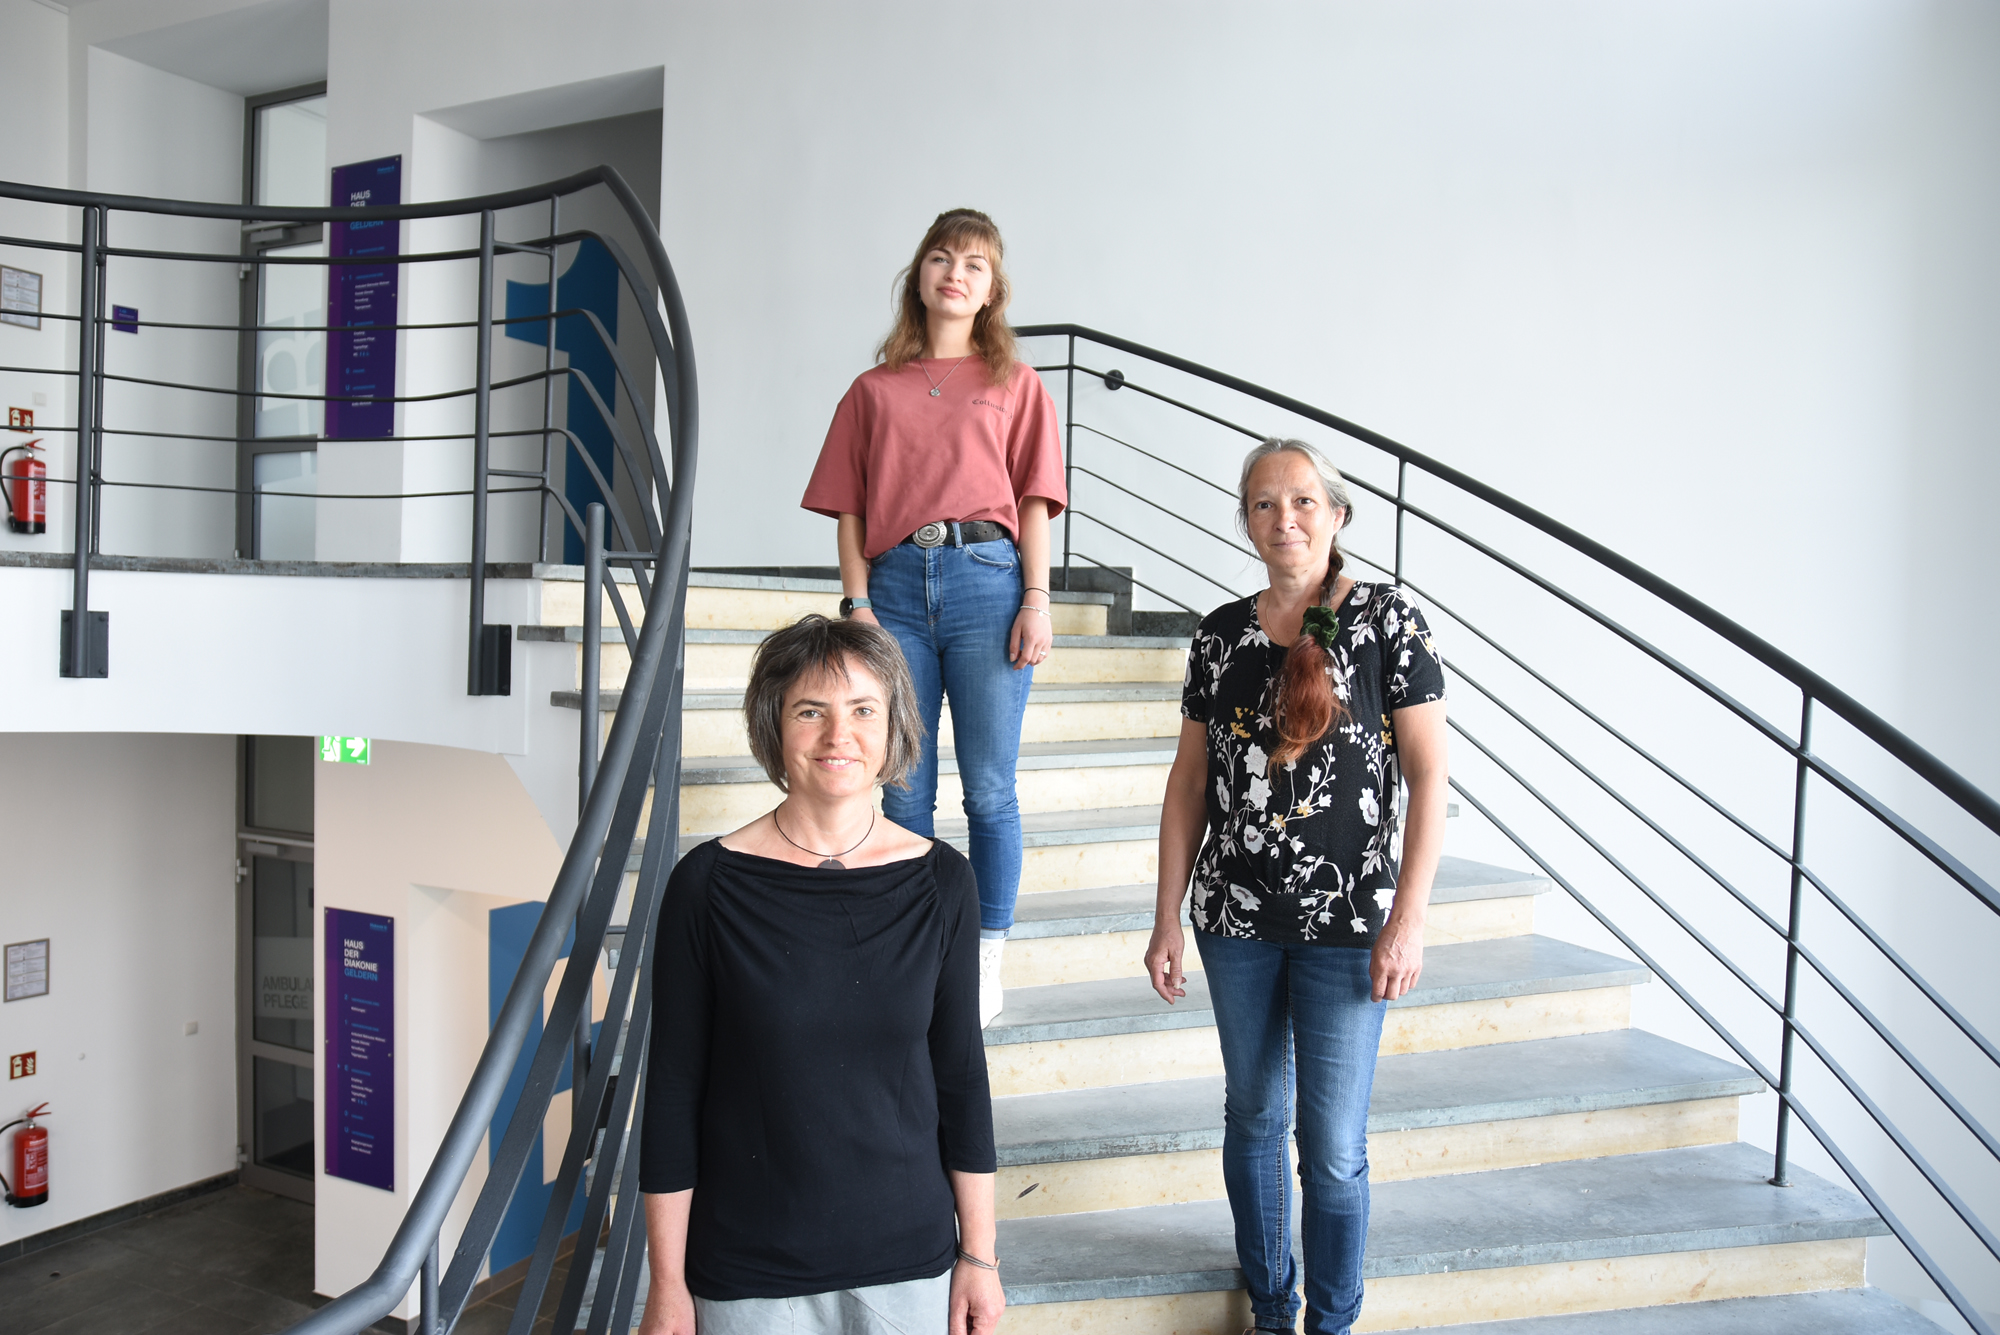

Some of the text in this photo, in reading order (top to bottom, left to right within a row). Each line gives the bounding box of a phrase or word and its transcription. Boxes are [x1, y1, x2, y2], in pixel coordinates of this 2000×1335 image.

[350, 189, 371, 201] HAUS
[972, 398, 1008, 415] Collusio
[344, 938, 364, 951] HAUS
[344, 948, 359, 959] DER
[344, 957, 378, 973] DIAKONIE
[344, 967, 378, 981] GELDERN
[263, 975, 314, 992] AMBULA
[264, 993, 308, 1009] PFLEGE
